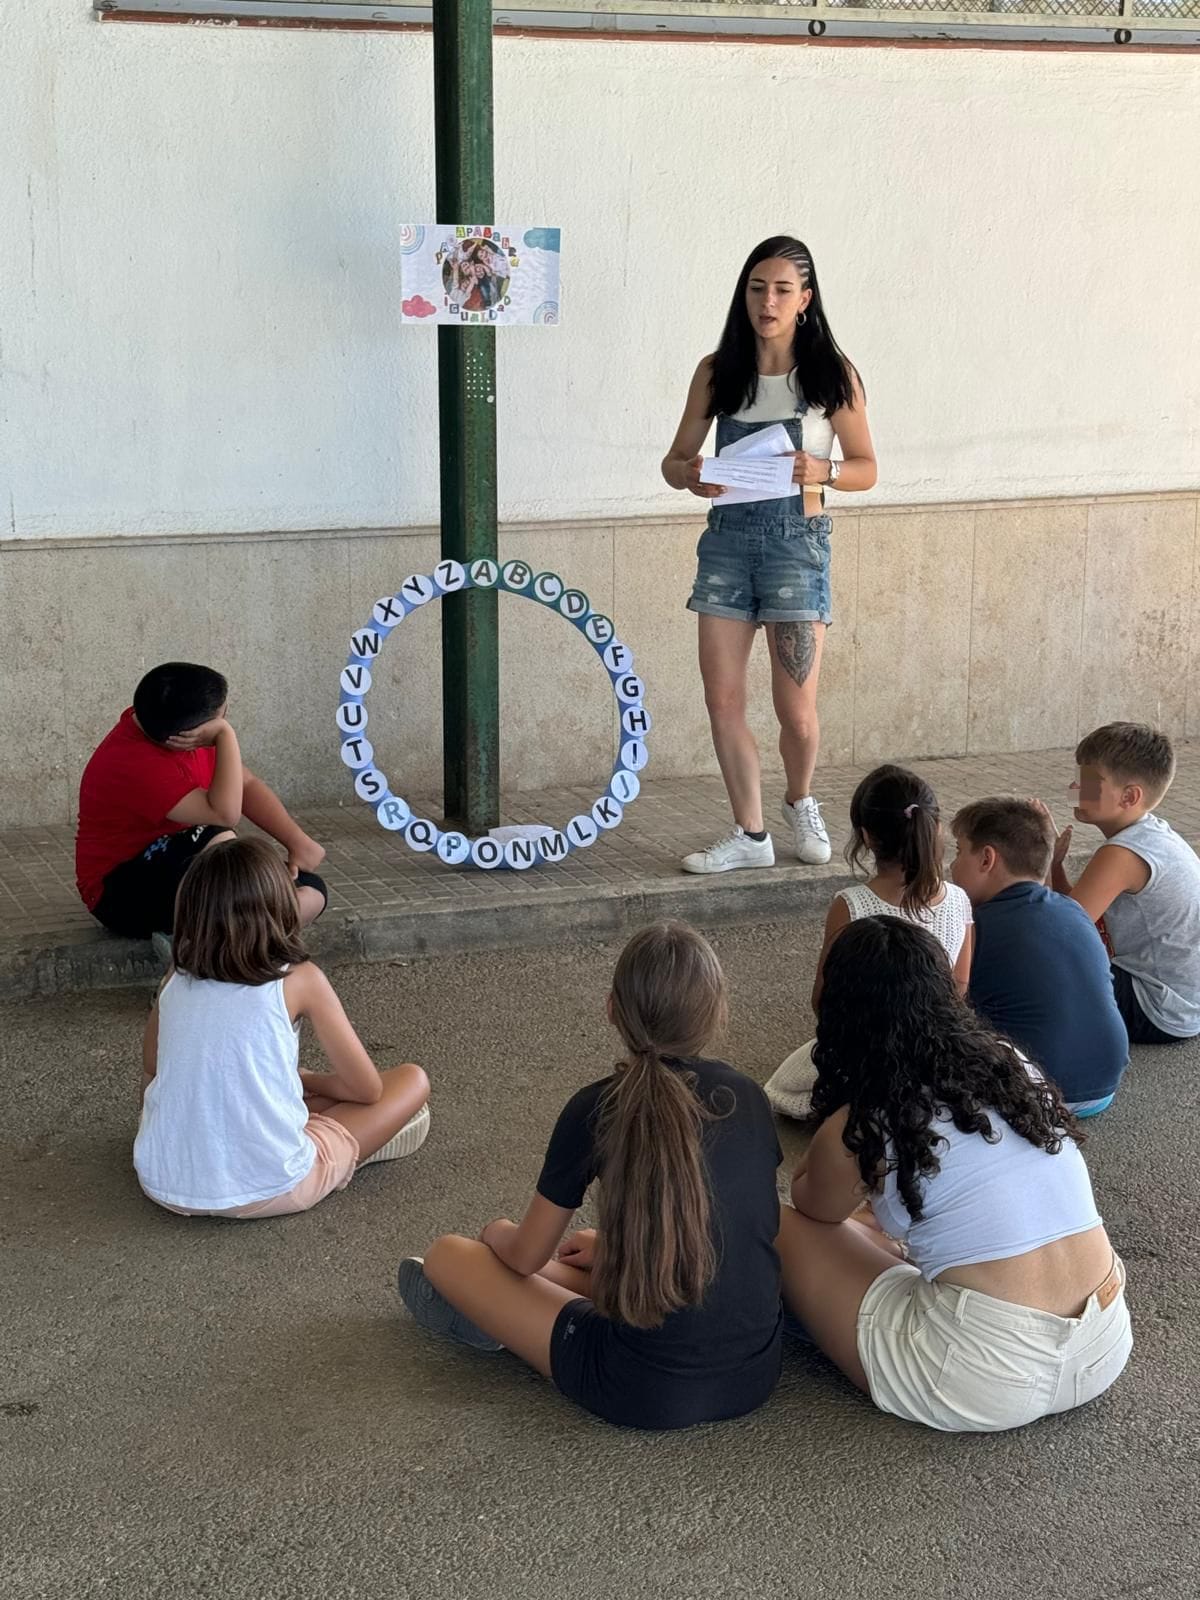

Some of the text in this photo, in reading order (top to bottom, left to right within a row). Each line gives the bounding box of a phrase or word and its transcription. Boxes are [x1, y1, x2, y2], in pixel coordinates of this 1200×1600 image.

[344, 561, 646, 863] A B C D E F G H I J K L M N O P Q R S T U V W X Y Z
